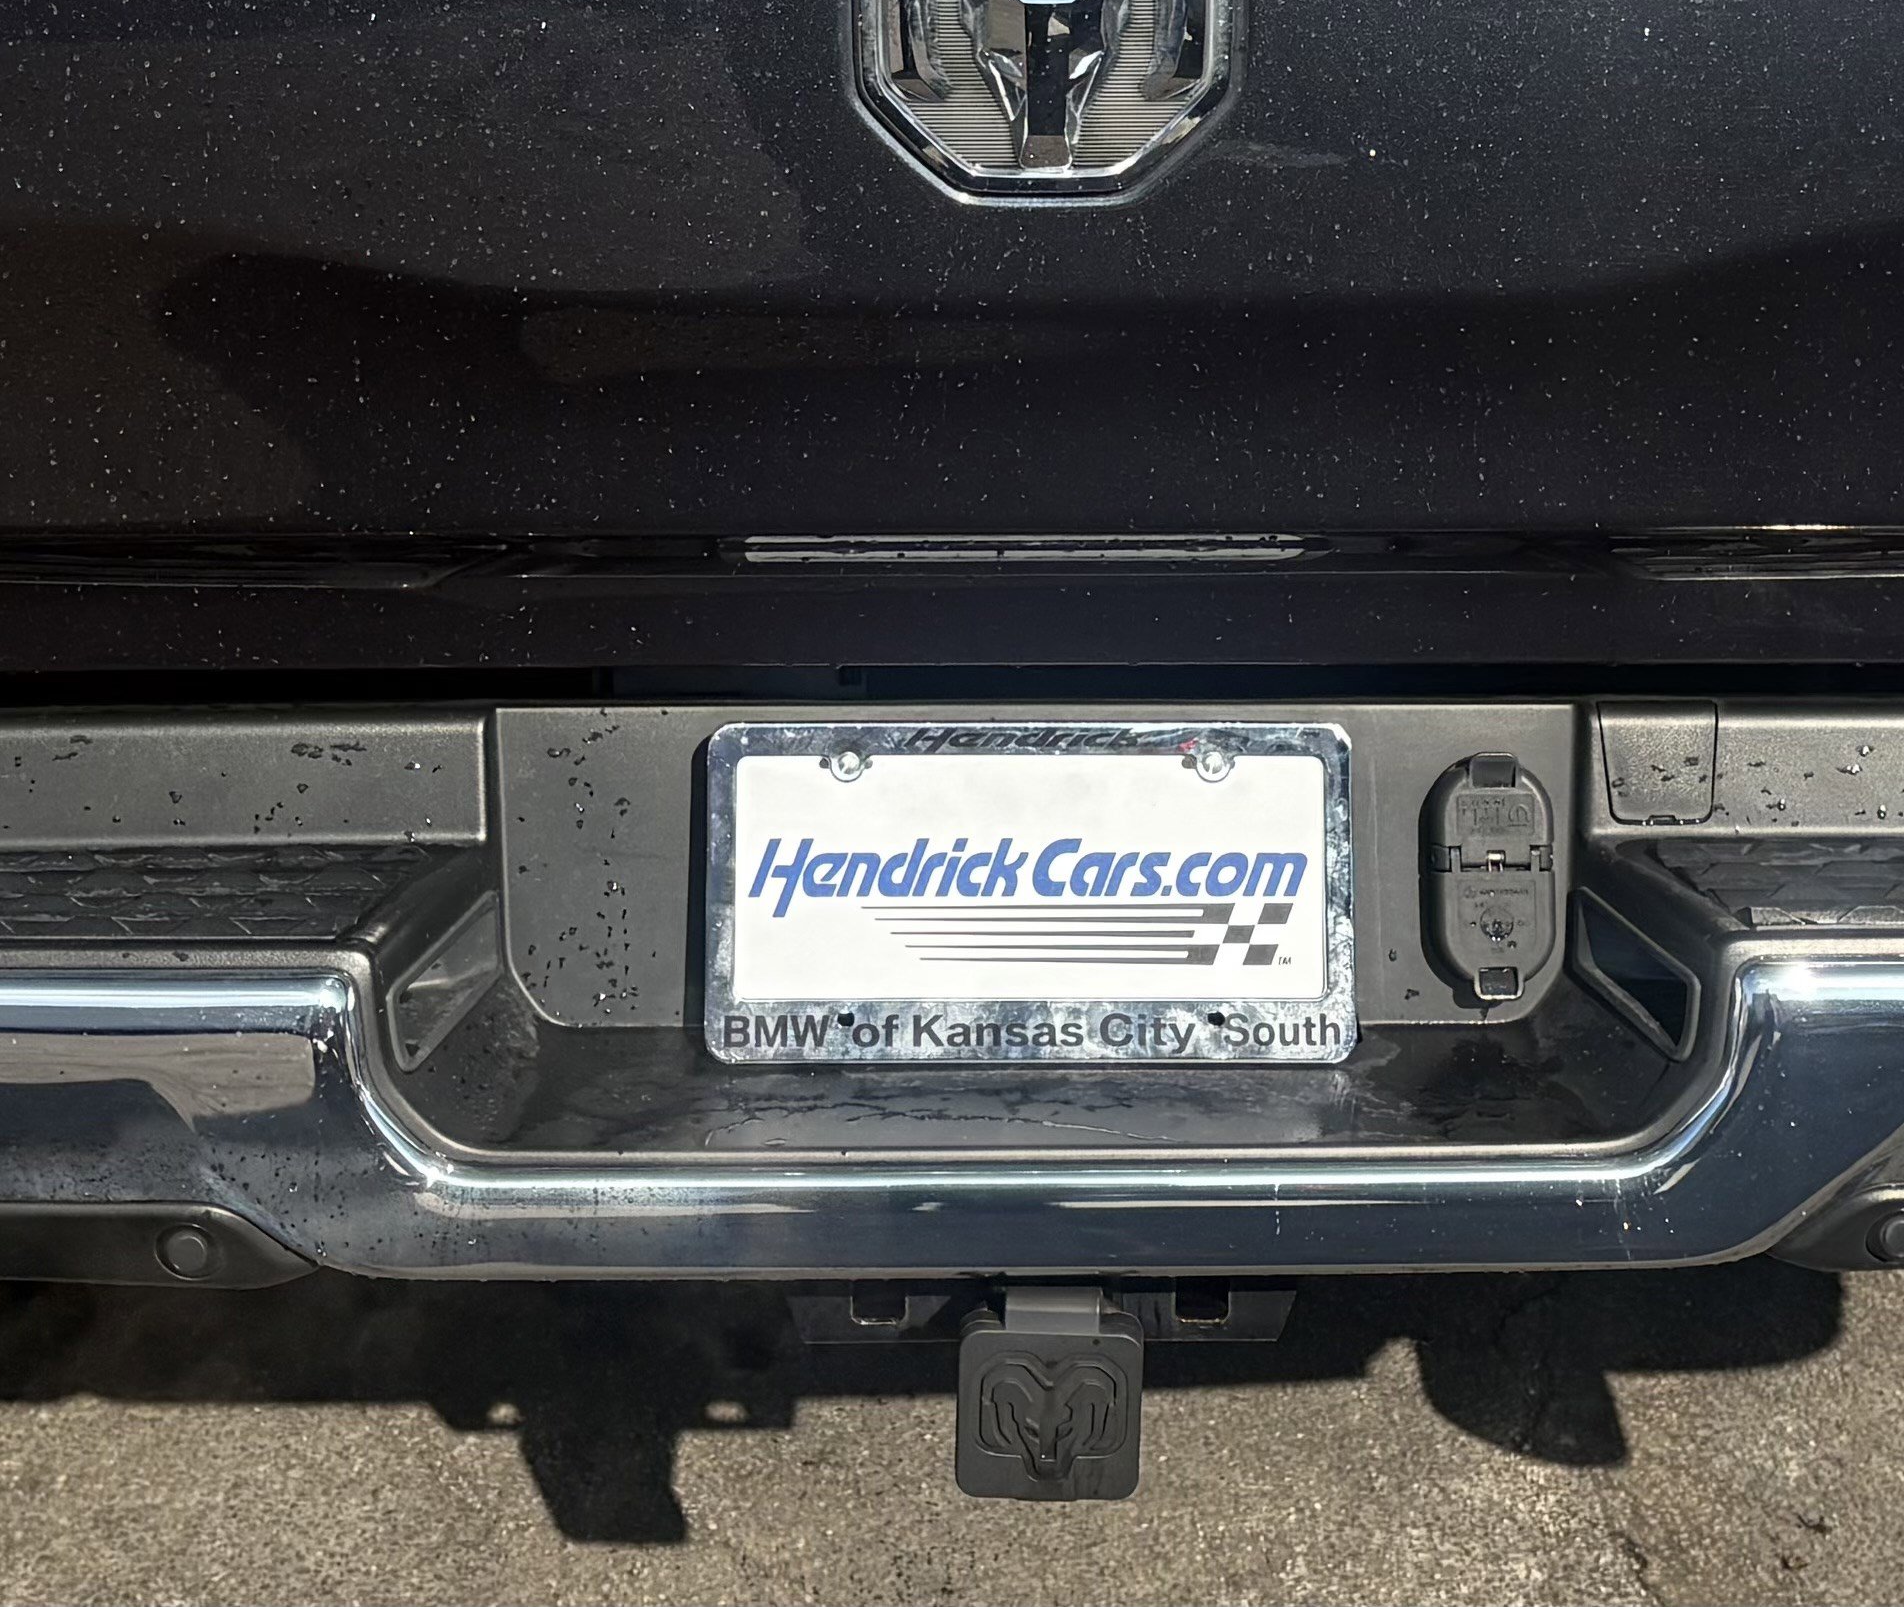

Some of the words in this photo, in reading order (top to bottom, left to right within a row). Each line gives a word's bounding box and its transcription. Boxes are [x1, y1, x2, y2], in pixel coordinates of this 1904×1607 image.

[903, 726, 1139, 754] Hendrick
[722, 1013, 830, 1048] BMW
[851, 1013, 900, 1048] of
[911, 1013, 1085, 1048] Kansas
[1099, 1012, 1196, 1054] City
[1223, 1012, 1342, 1047] South
